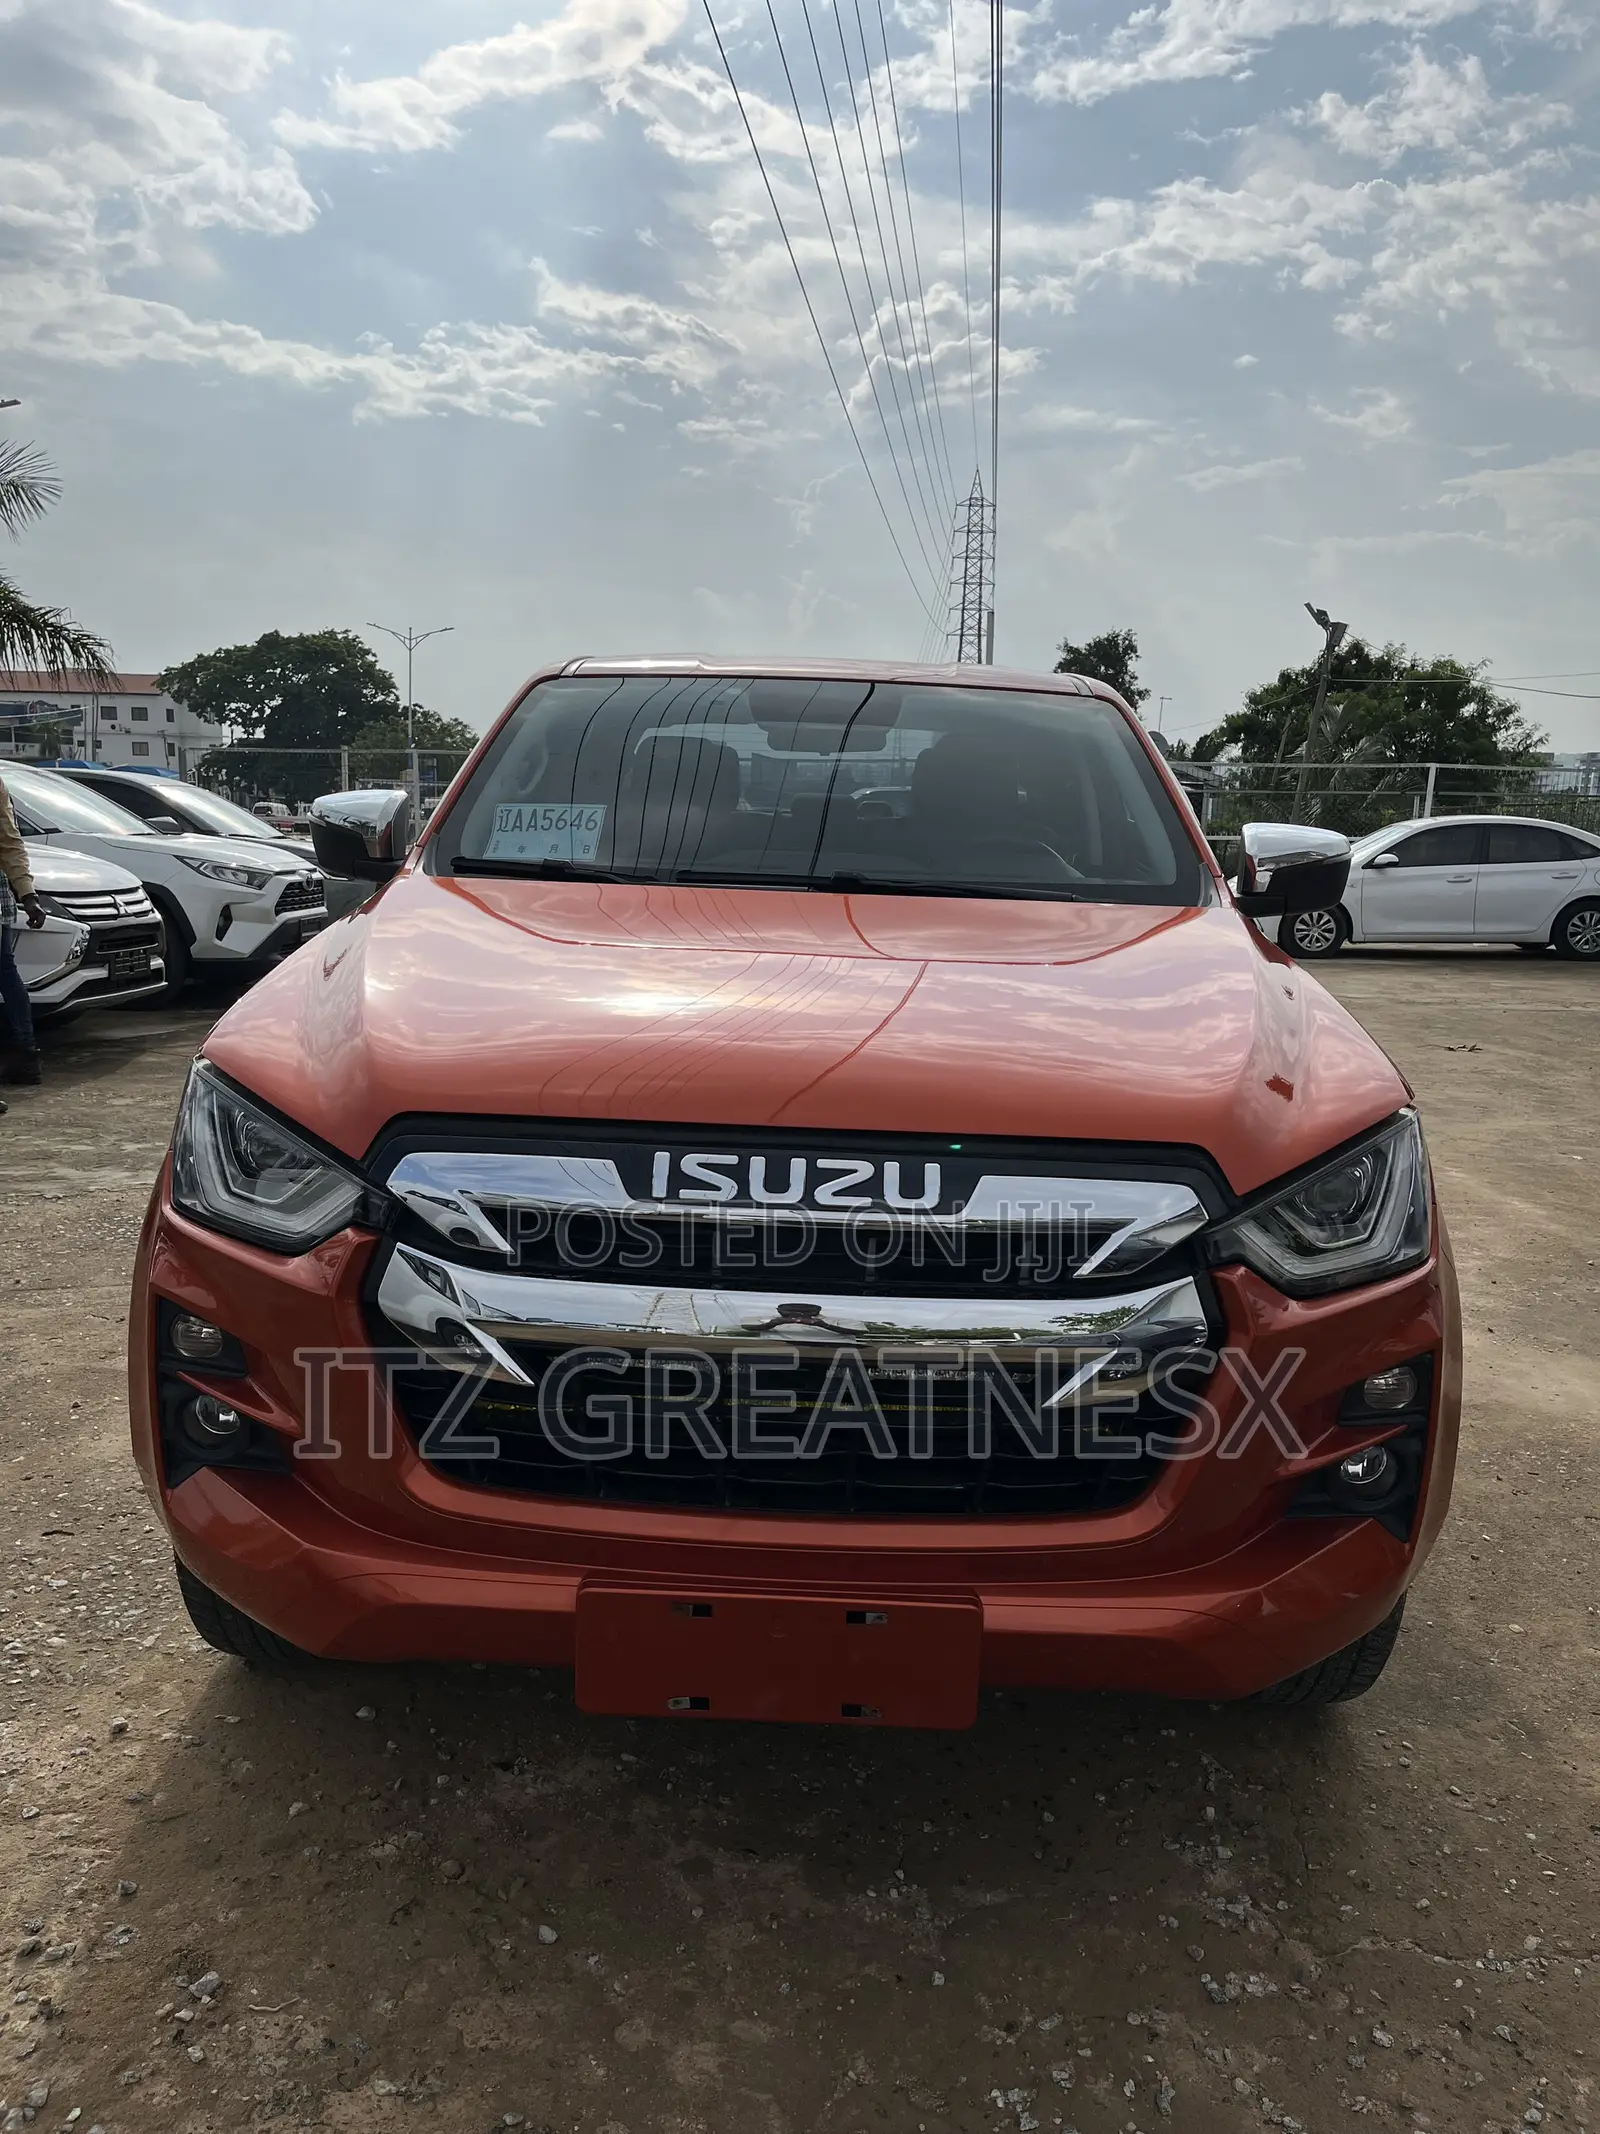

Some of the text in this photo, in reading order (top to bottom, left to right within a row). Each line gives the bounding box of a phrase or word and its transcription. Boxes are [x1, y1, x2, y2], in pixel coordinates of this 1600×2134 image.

[496, 808, 598, 832] 辽AA5646
[549, 844, 559, 854] 月
[651, 1151, 941, 1208] ISUZU
